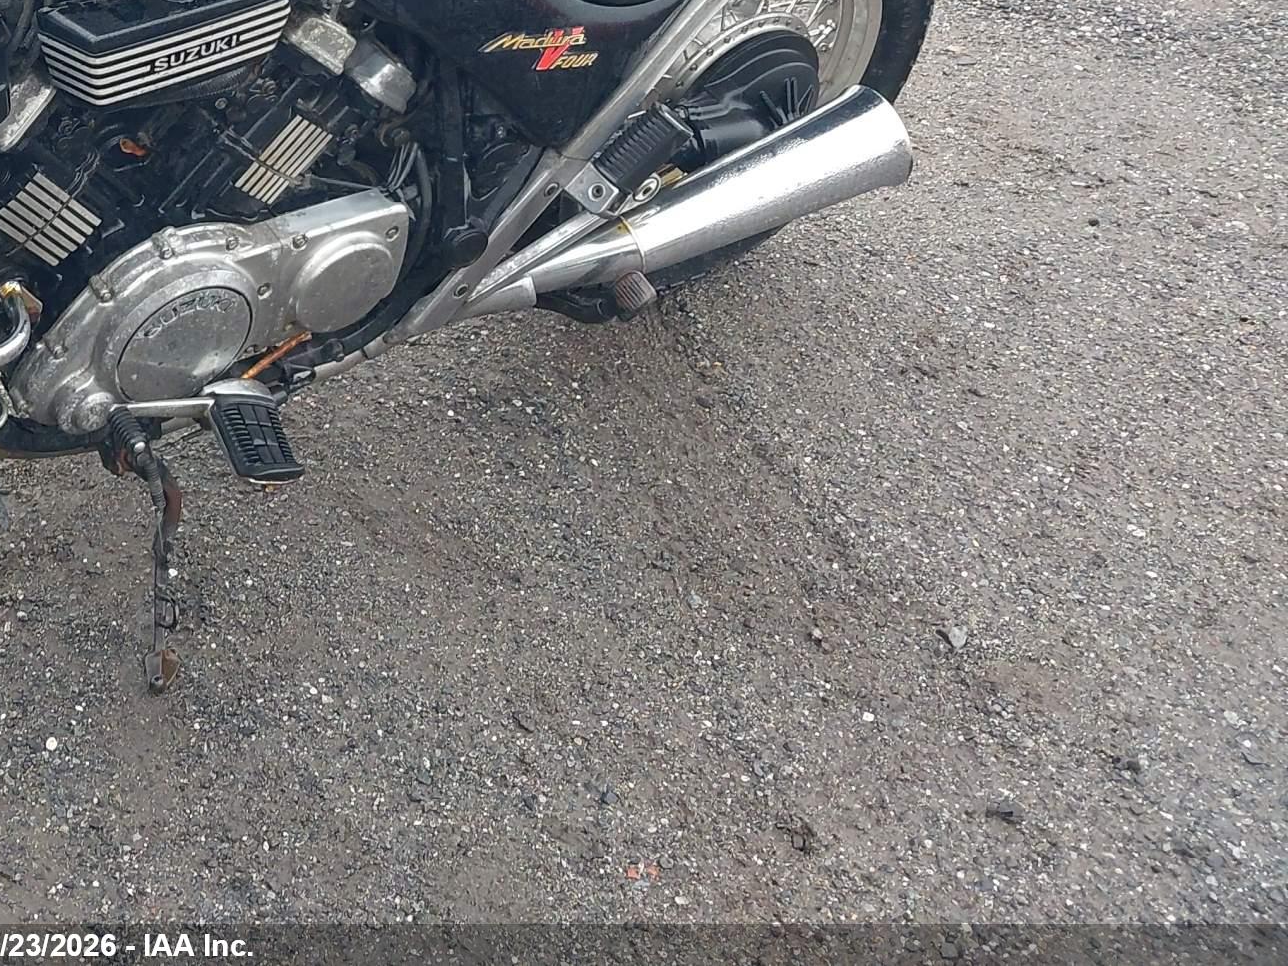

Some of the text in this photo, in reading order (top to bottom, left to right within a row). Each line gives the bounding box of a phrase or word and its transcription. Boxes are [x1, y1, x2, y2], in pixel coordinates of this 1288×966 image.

[154, 34, 238, 72] SUZUKI
[478, 29, 586, 52] Madura
[535, 26, 598, 70] V FOUR
[143, 290, 239, 338] SUZUKI
